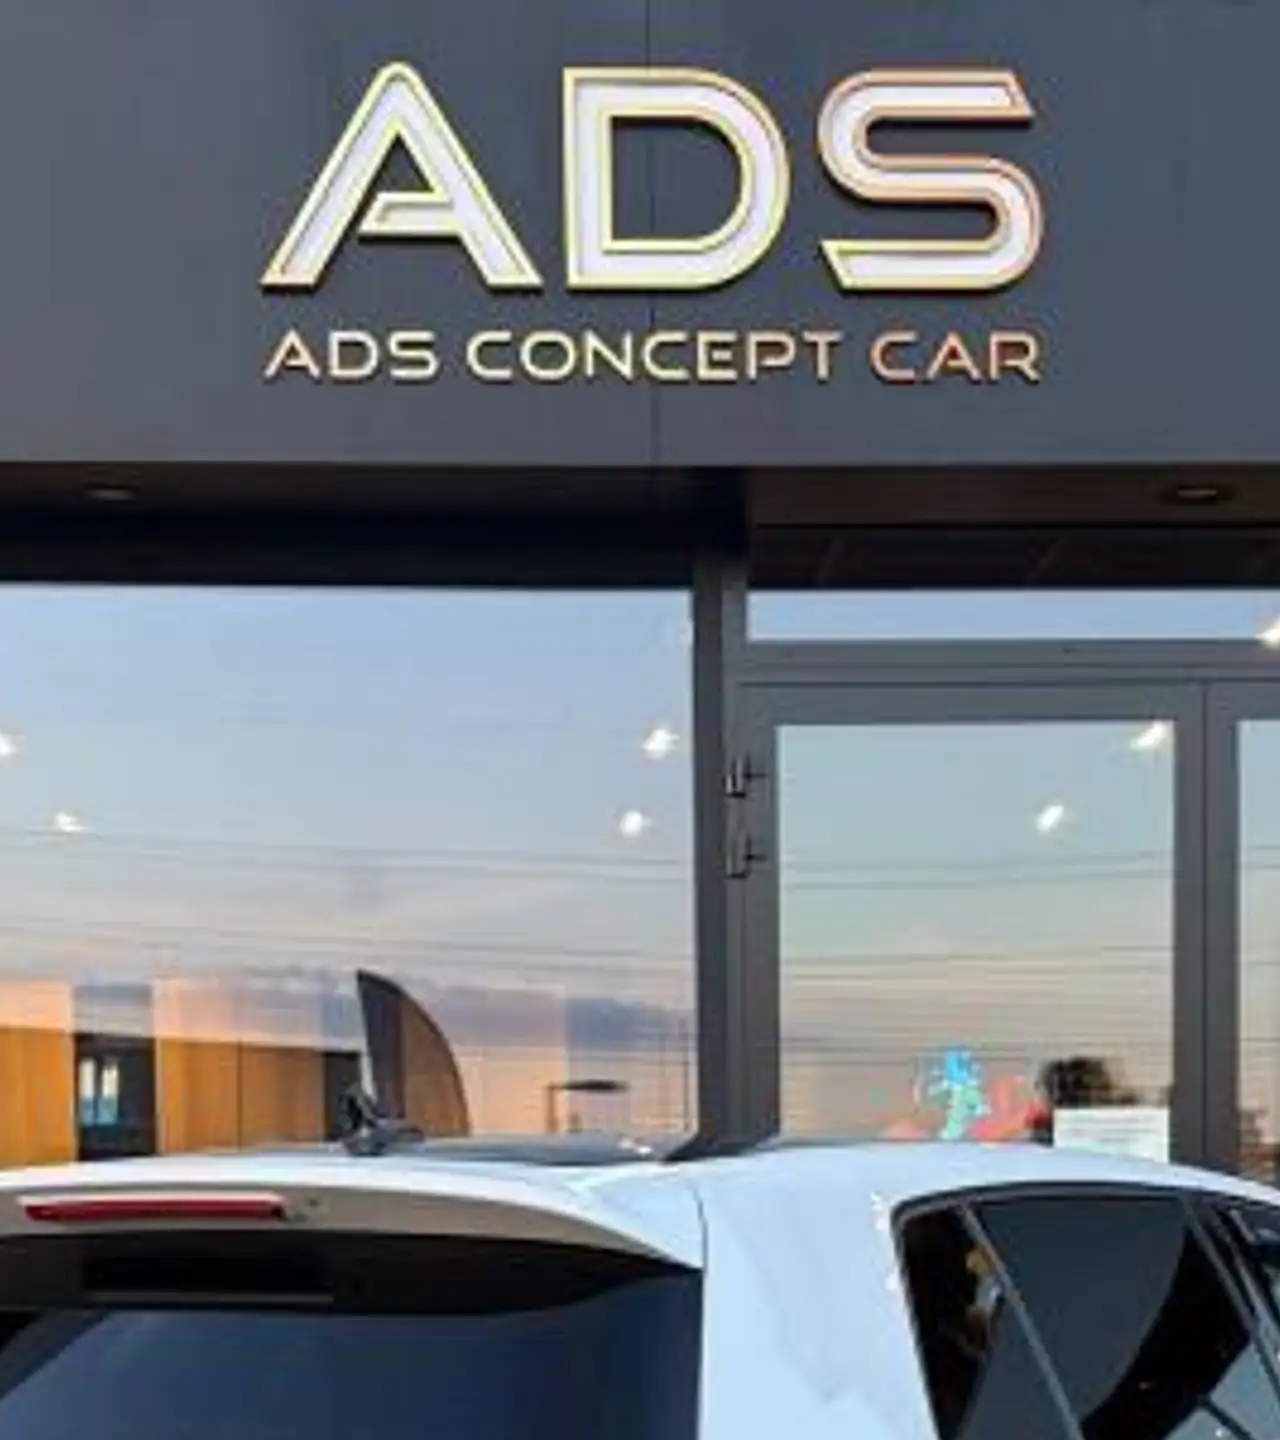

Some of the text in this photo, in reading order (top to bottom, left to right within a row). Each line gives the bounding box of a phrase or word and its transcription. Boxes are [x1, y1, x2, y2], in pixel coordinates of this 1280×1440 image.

[261, 61, 1044, 292] ADS
[263, 328, 1042, 384] ADS CONCEPT CAR
